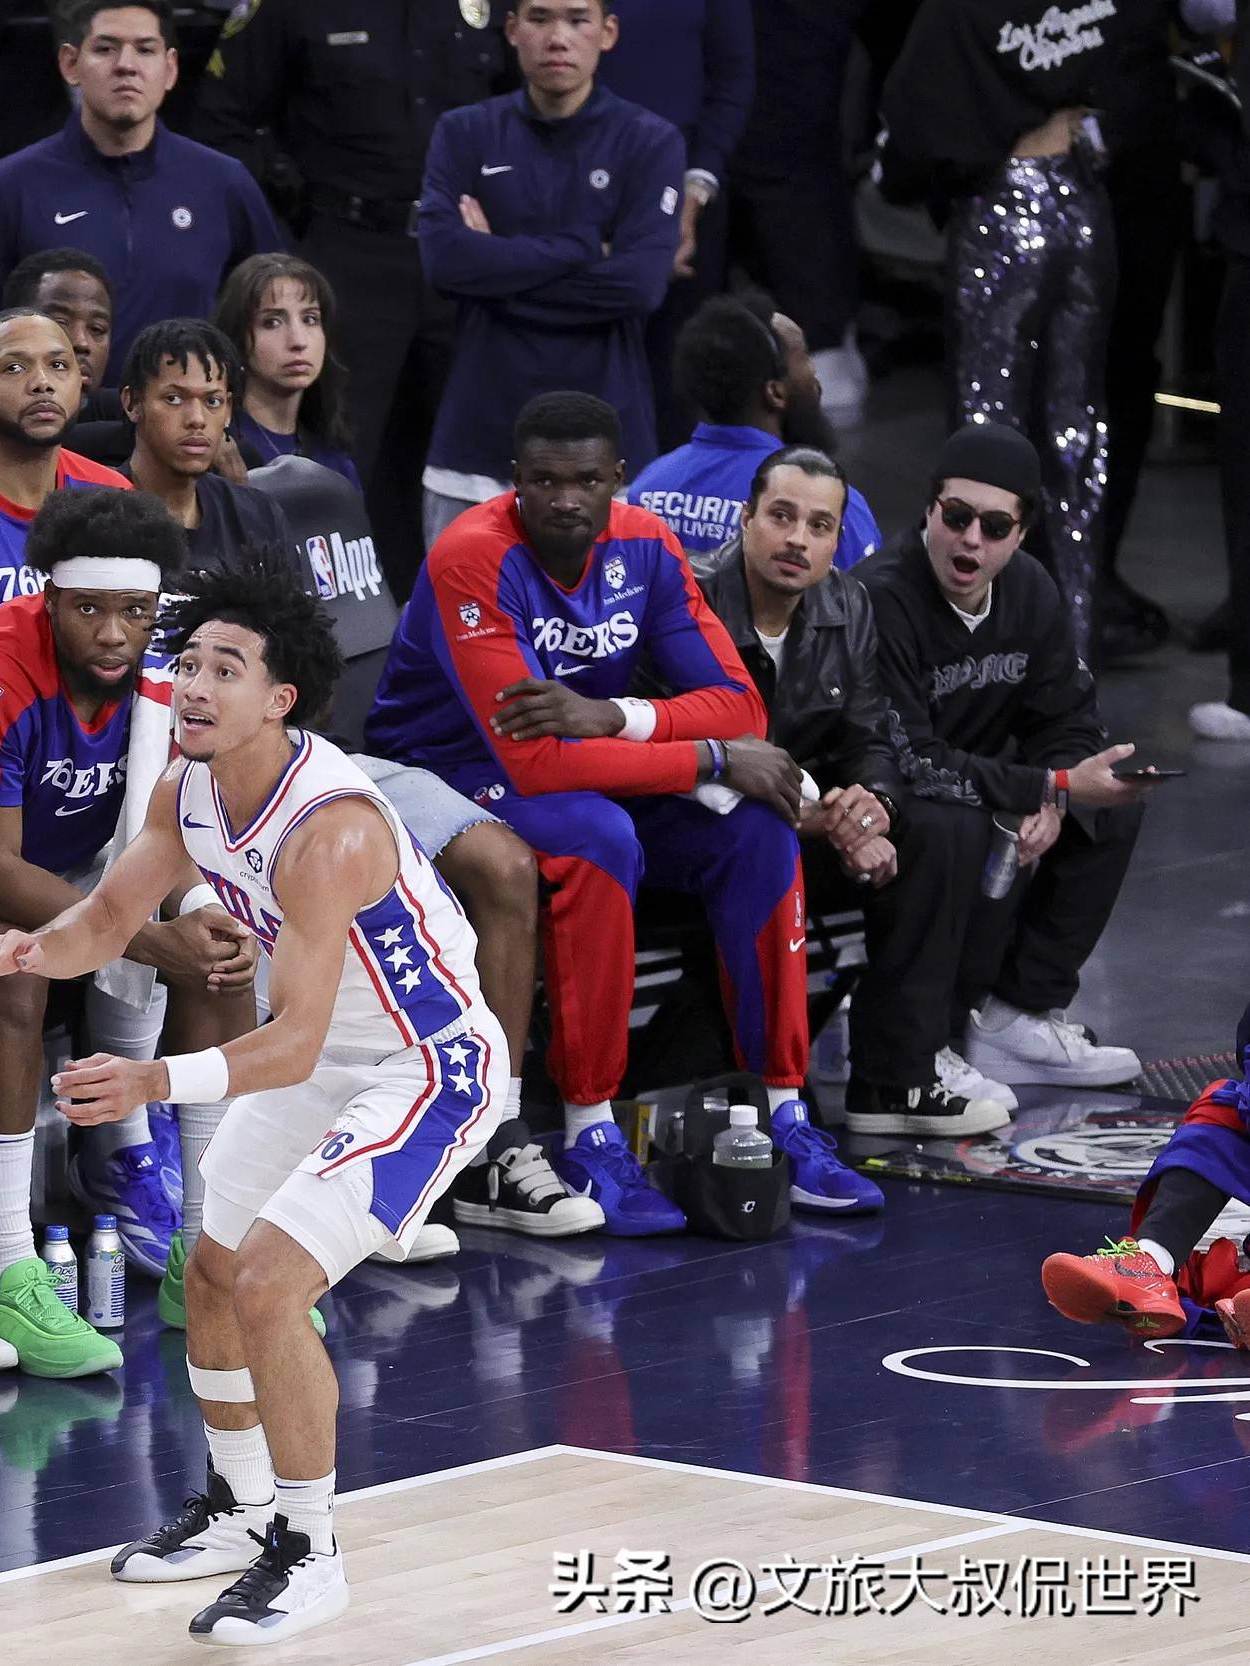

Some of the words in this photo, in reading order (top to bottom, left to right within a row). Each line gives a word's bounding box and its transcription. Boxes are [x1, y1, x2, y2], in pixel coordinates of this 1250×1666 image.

[682, 520, 726, 541] LIVES
[329, 531, 383, 602] App
[532, 610, 639, 659] 76ERS
